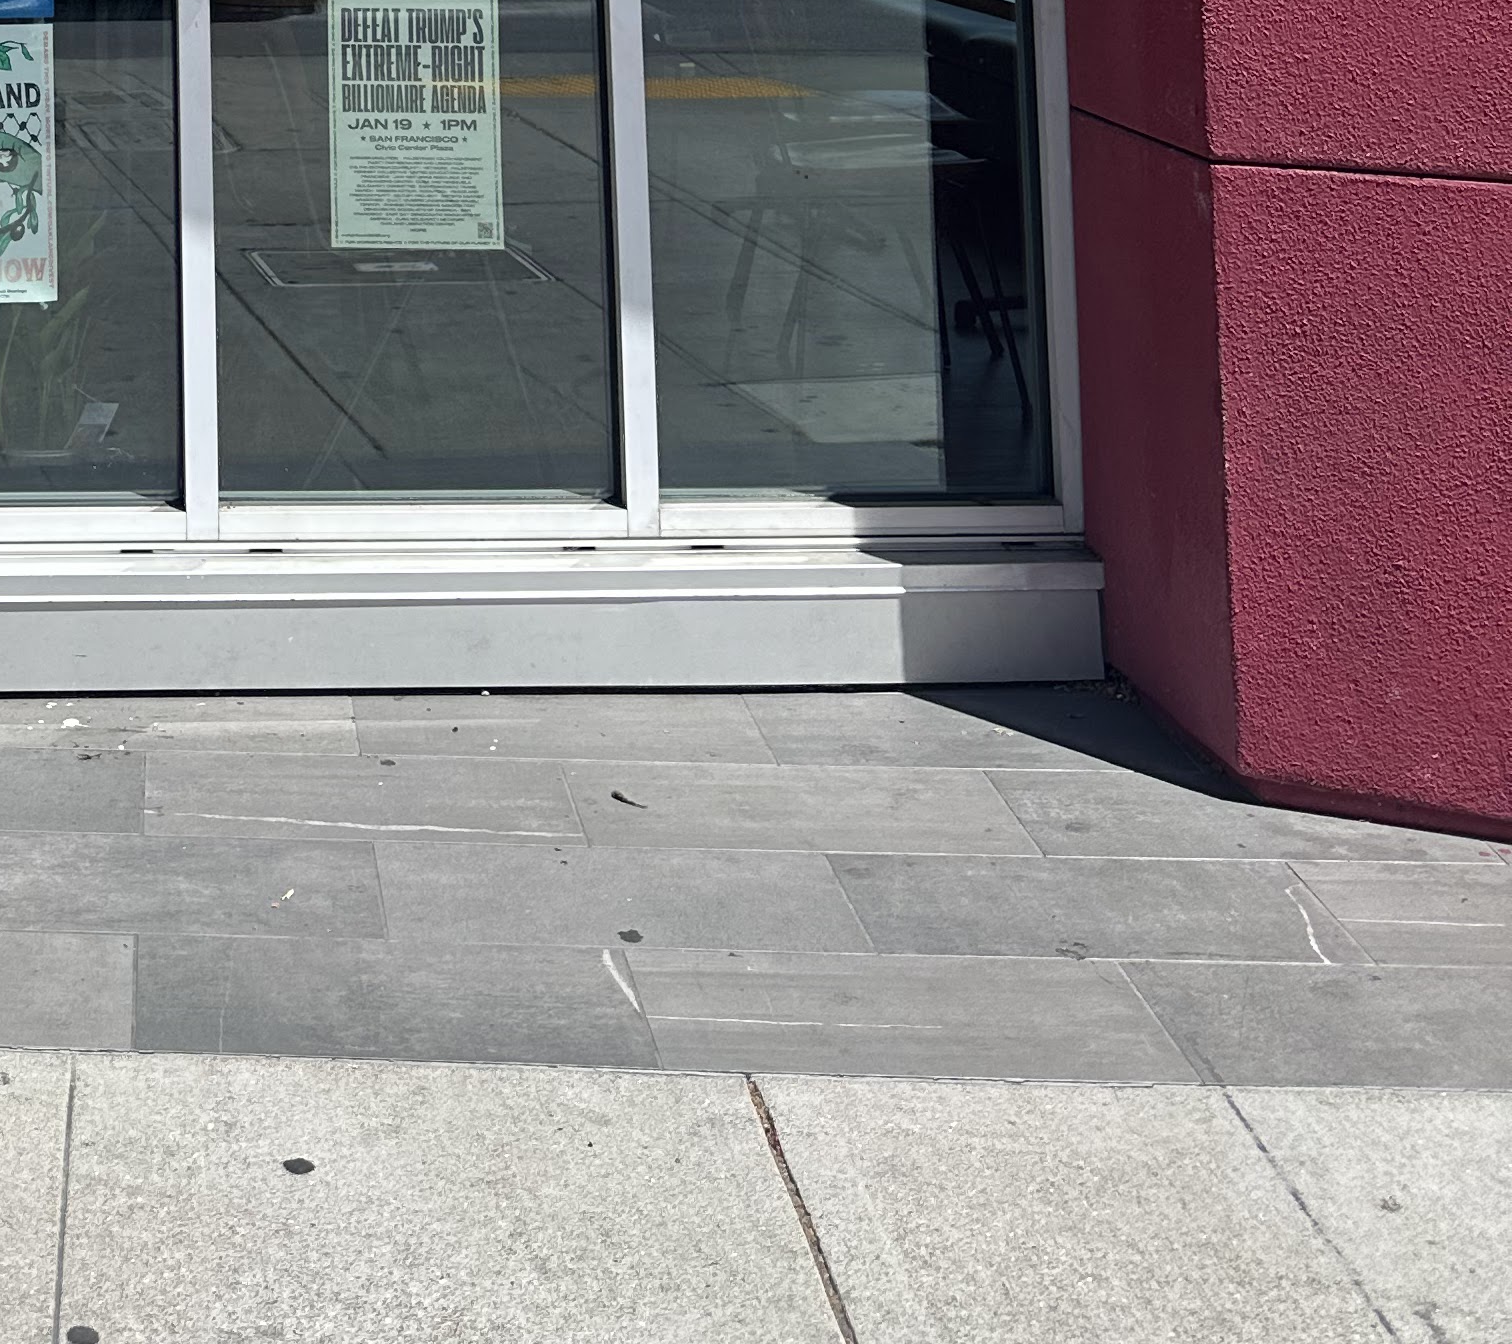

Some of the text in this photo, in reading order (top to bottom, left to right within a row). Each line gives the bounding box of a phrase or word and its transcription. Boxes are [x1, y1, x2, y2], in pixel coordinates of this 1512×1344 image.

[340, 7, 485, 45] DEFEAT TRUMP'S
[341, 44, 486, 83] EXTREME-RIGHT
[341, 84, 488, 114] BILLIONAIRE AGENDA
[347, 118, 478, 132] JAN 19 1PM
[369, 135, 459, 143] SAN FRANCISCO
